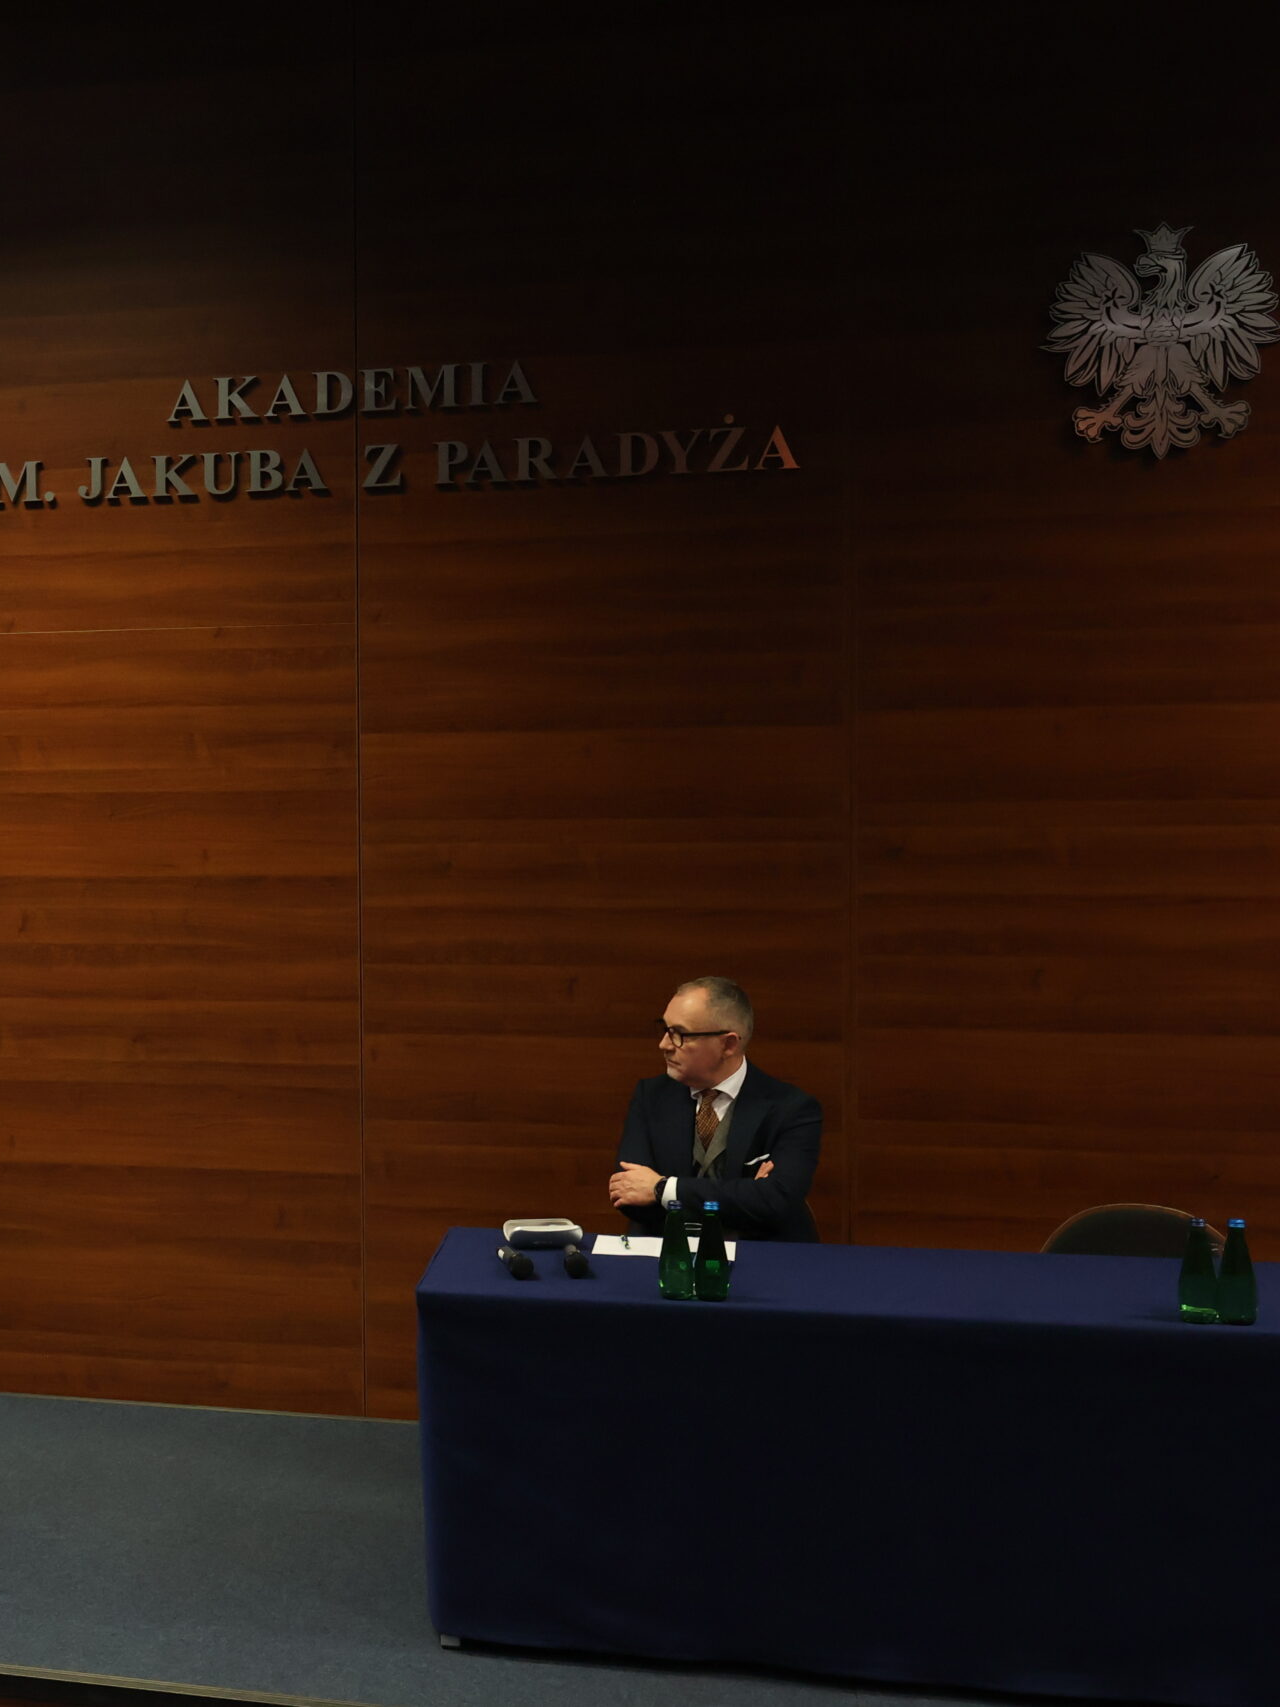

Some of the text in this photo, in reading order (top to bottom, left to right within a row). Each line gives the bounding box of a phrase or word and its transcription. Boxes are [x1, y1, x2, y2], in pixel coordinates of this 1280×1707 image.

[166, 359, 540, 424] AKADEMIA
[77, 447, 329, 501] JAKUBA
[362, 443, 402, 489] Z
[432, 413, 801, 487] PARADYŻA
